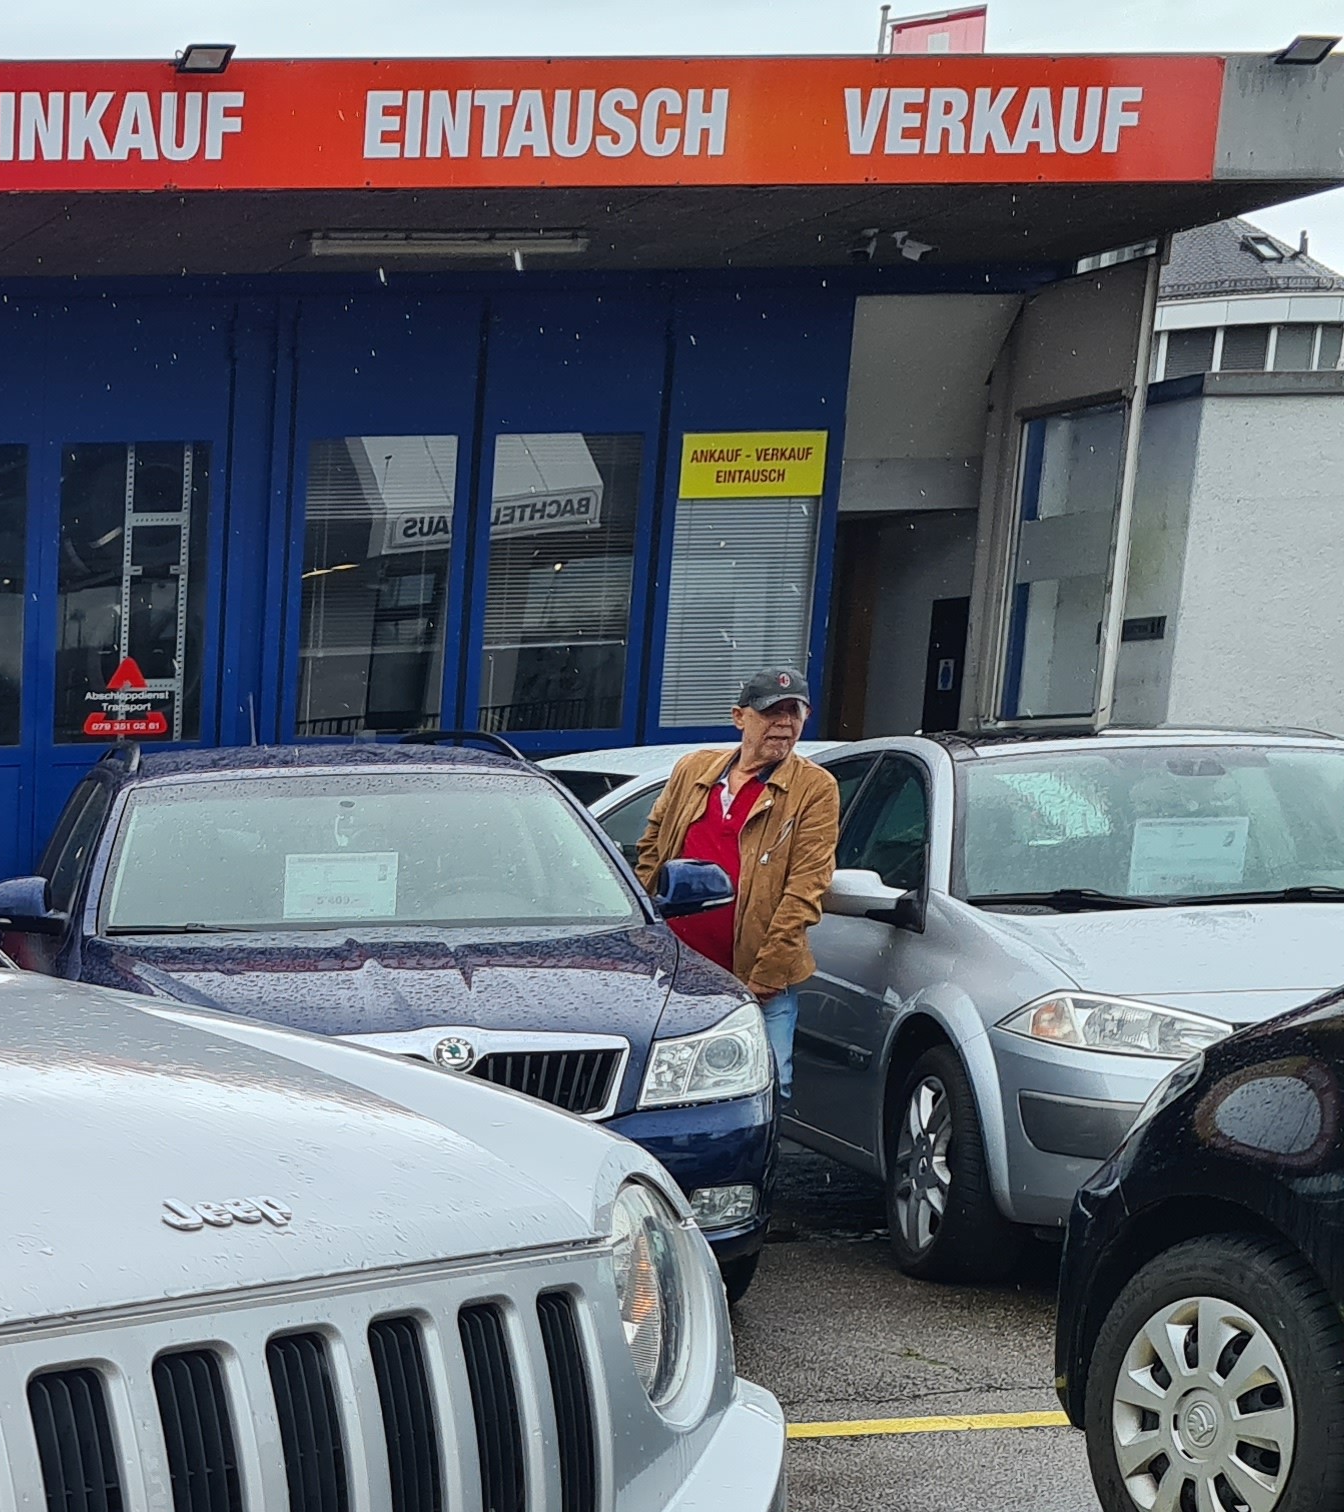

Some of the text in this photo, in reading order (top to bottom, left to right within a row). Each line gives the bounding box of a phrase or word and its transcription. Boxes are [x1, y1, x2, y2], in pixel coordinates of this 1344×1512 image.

[362, 87, 729, 159] EINTAUSCH
[844, 86, 1143, 155] VERKAUF
[690, 448, 742, 463] ANKAUF
[755, 446, 813, 462] VERKAUF
[715, 468, 786, 484] EINTAUSCH
[84, 691, 169, 701] Abschleppdienst
[101, 702, 151, 712] Transport
[91, 722, 111, 731] 079
[113, 722, 130, 731] 351
[133, 722, 146, 731] 02
[162, 1194, 292, 1232] Jeep
